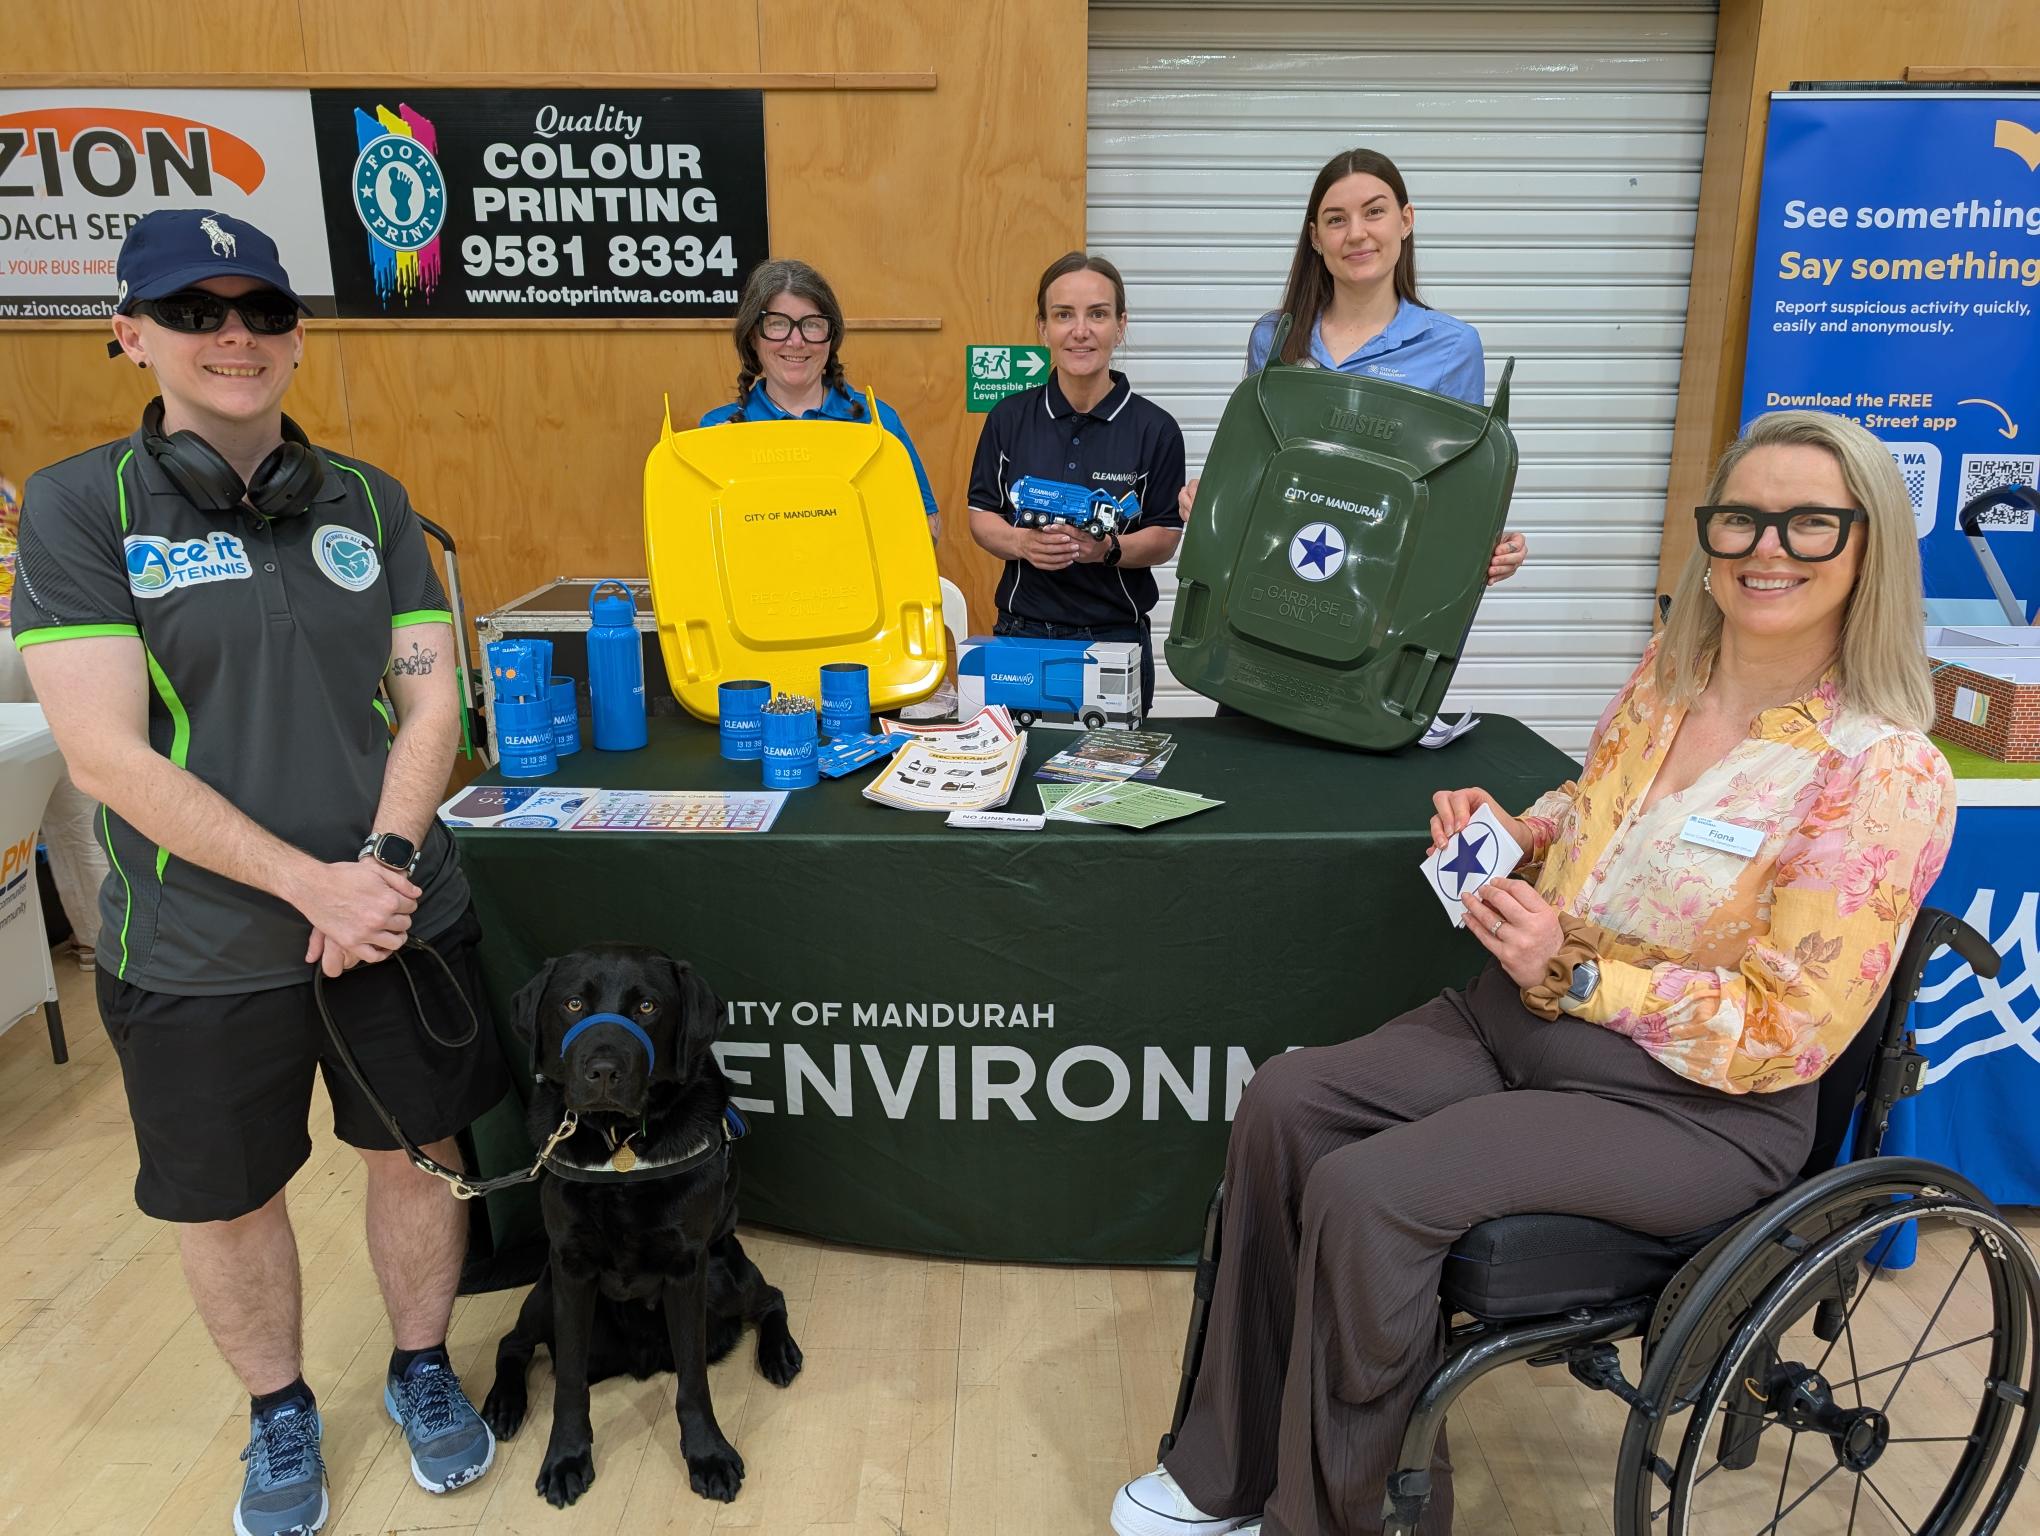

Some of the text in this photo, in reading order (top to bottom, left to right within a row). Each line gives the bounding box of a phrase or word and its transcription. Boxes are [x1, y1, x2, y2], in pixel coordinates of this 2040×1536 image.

[534, 104, 642, 139] Quality
[0, 129, 213, 198] ZION
[366, 145, 429, 170] FOOT
[483, 143, 702, 179] COLOUR
[472, 187, 718, 223] PRINTING
[1783, 199, 2040, 235] See something
[372, 216, 434, 243] PRINT
[461, 235, 738, 277] 9581 8334
[8, 260, 48, 275] YOUR
[51, 260, 80, 275] BUS
[83, 260, 116, 275] HIRE
[1779, 251, 2040, 286] Say something
[465, 286, 738, 306] www.footprintwa.com.au
[1775, 300, 2031, 316] Report suspicious activity quickly,
[1773, 319, 1954, 336] easily and anonymously.
[973, 382, 1023, 390] Accessible
[973, 392, 997, 400] Level
[1767, 393, 1932, 408] Download the FREE
[1865, 414, 1919, 428] Street
[1923, 417, 1957, 431] app
[752, 447, 811, 464] MASTEC
[1903, 453, 1926, 464] WA
[1285, 487, 1384, 519] CITY OF MANDURAH
[744, 508, 837, 522] CITY OF MANDURAH
[213, 536, 242, 560] it
[174, 562, 247, 583] TENNIS
[1267, 585, 1341, 616] GARBAGE
[1279, 602, 1320, 624] ONLY
[991, 673, 1034, 685] CLEANAWAY
[505, 729, 554, 744] CLEANAWAY
[764, 743, 811, 758] CLEANAWAY
[1709, 829, 1734, 842] Fiona
[791, 1001, 843, 1027] OF
[852, 1002, 1055, 1028] MANDURAH
